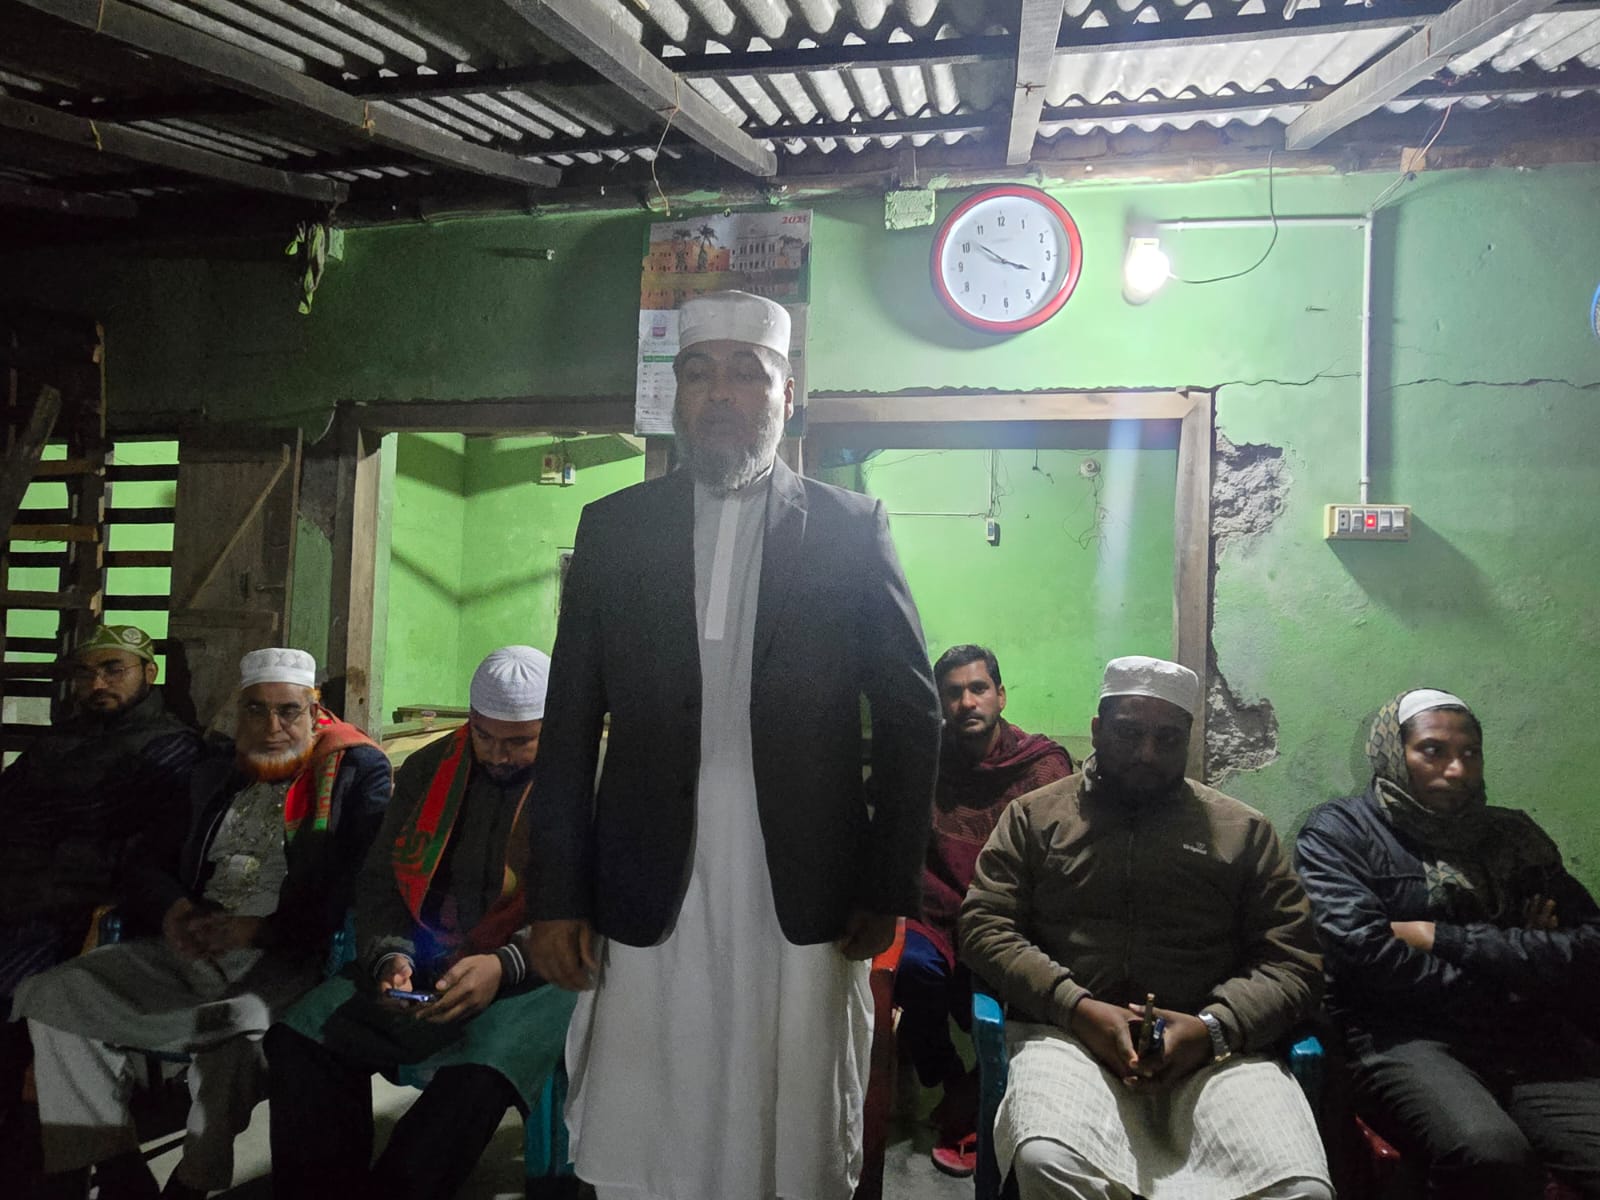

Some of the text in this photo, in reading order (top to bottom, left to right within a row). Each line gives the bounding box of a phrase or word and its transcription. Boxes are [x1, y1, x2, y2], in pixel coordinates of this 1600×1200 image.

[997, 216, 1006, 227] 12
[1021, 220, 1025, 229] 1
[977, 225, 984, 235] 11
[1039, 233, 1044, 243] 2
[962, 242, 970, 254] 10
[1045, 250, 1051, 261] 3
[958, 262, 964, 272] 9
[1041, 272, 1046, 282] 4
[964, 281, 970, 292] 8
[982, 294, 986, 304] 7
[1025, 289, 1031, 300] 5
[1004, 297, 1008, 308] 6
